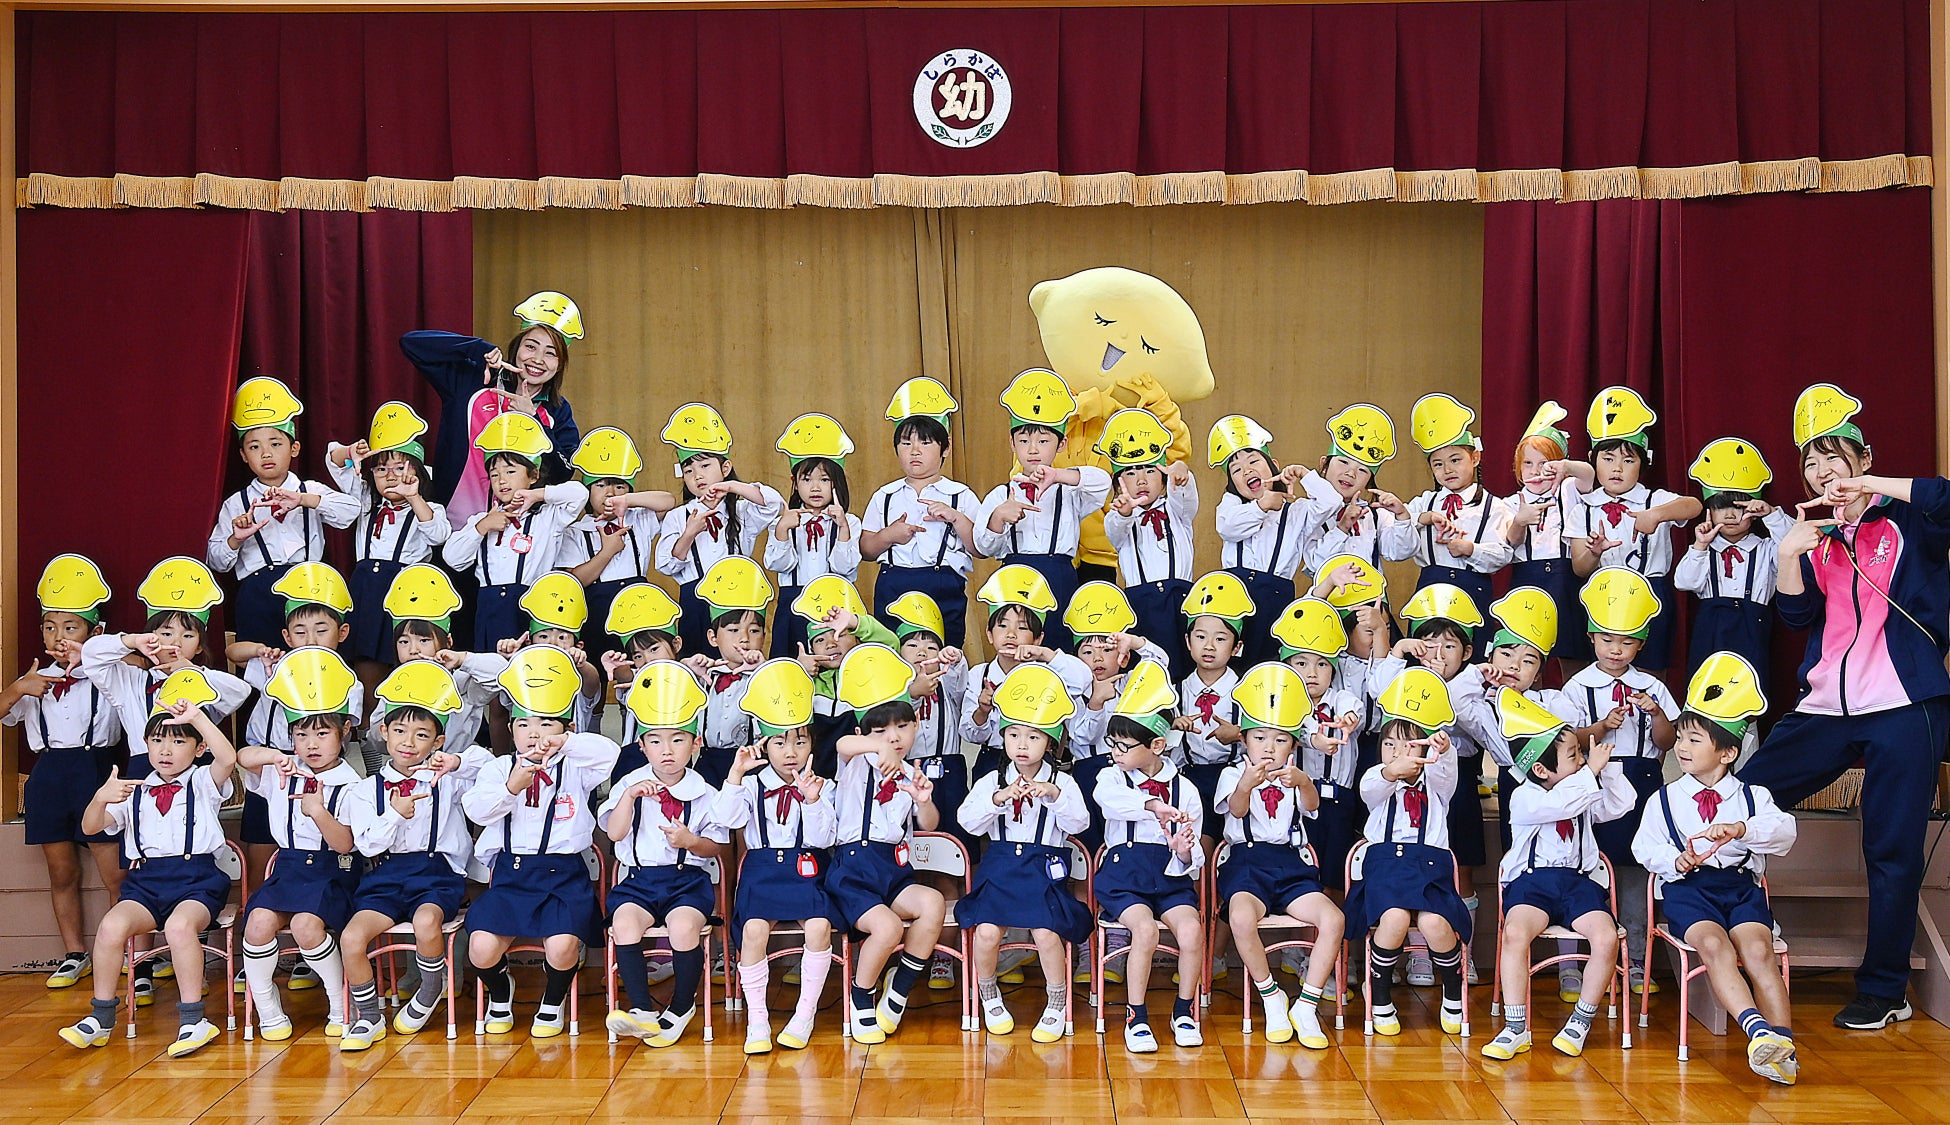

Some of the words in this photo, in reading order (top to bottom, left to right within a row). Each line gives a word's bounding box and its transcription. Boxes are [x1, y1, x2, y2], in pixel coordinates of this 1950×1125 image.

[923, 53, 1004, 80] しらかば
[939, 70, 986, 121] 幼
